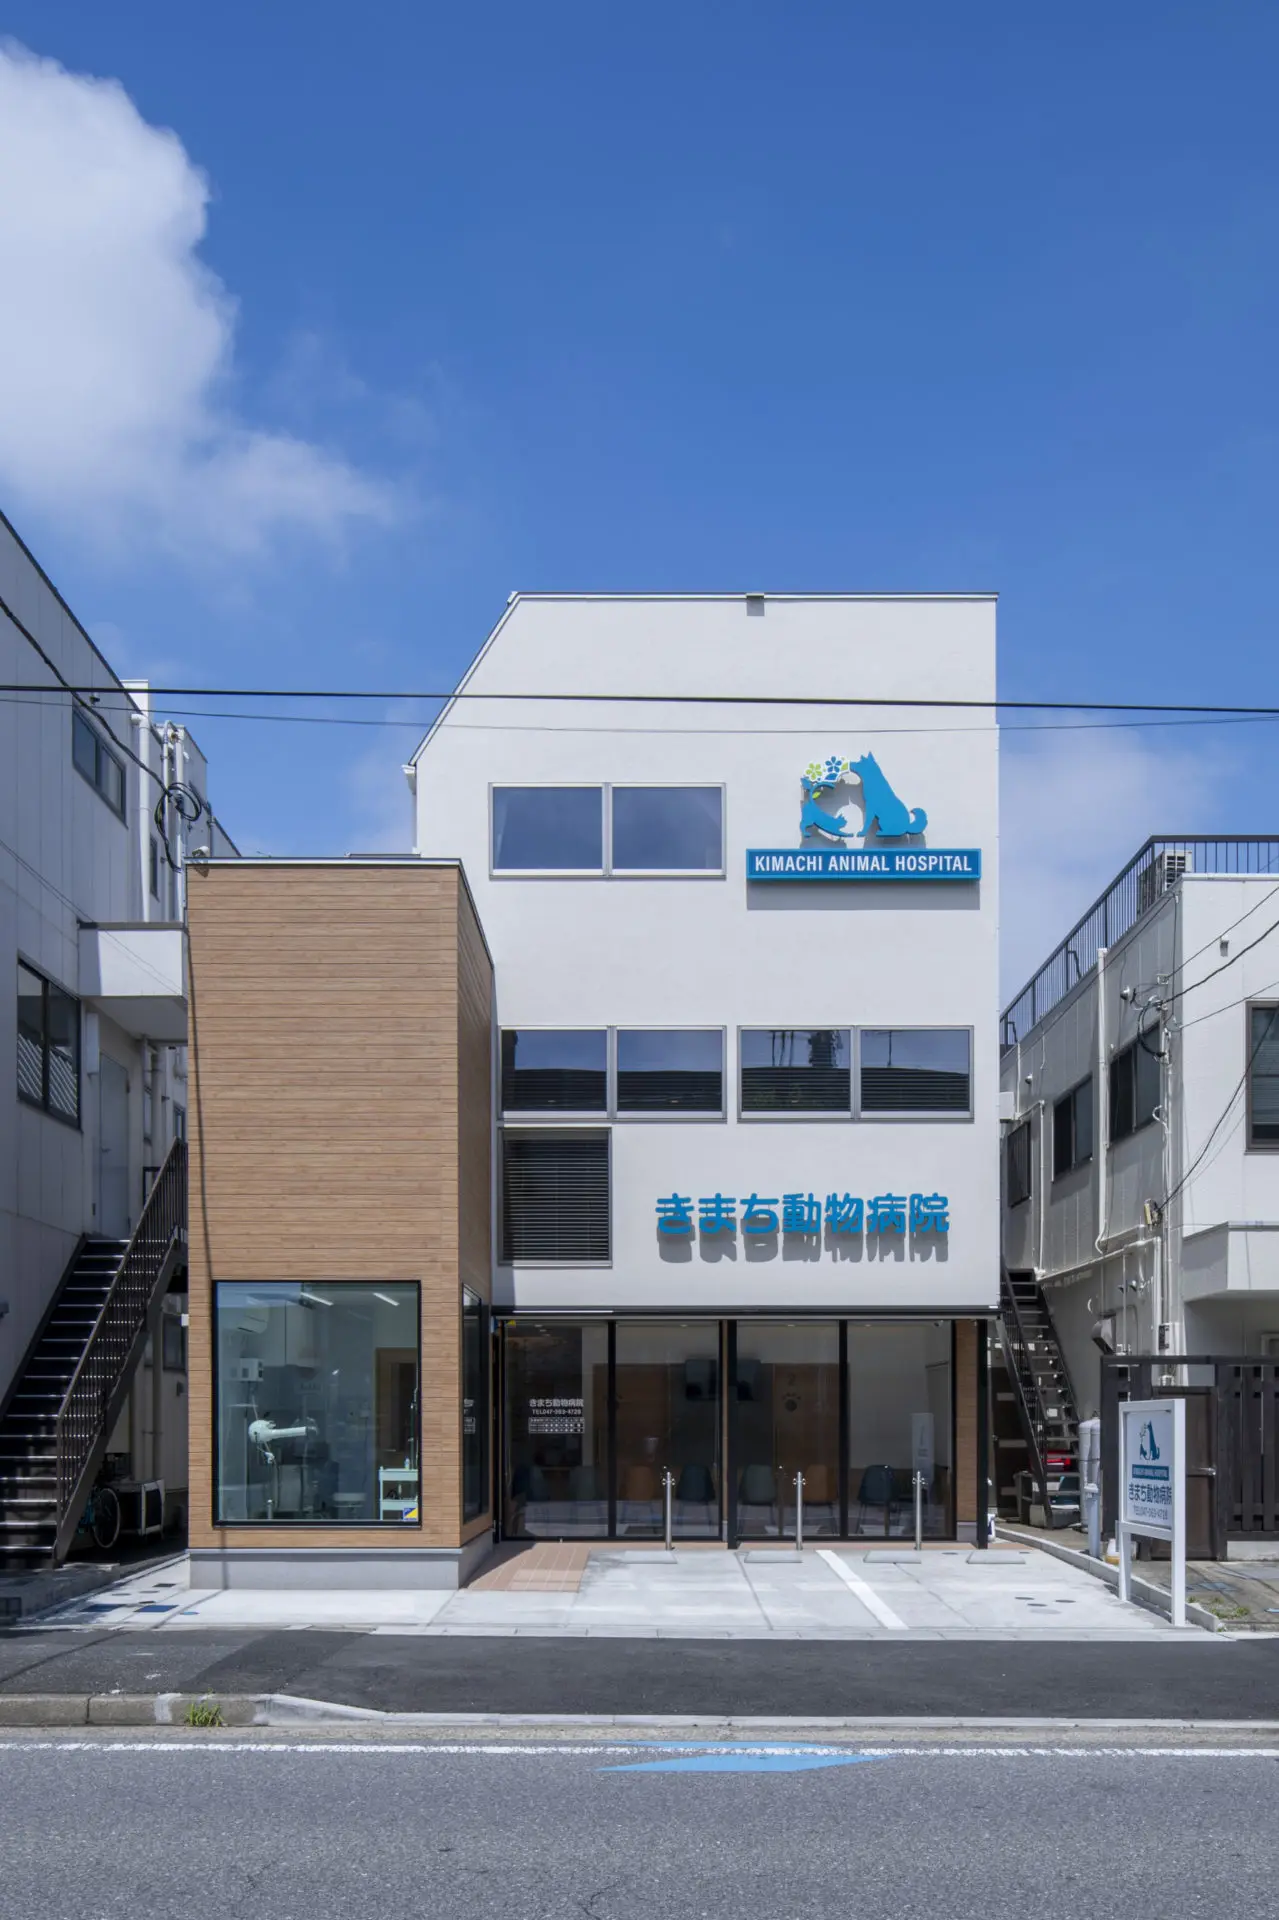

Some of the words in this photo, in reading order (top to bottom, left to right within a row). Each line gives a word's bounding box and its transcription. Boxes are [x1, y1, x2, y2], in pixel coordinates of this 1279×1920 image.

[755, 855, 823, 872] KIMACHI
[828, 855, 889, 872] ANIMAL
[896, 855, 972, 872] HOSPITAL
[655, 1192, 949, 1234] きまち動物病院
[529, 1398, 584, 1408] きまち動物病院
[1129, 1482, 1172, 1505] きまち動物病院
